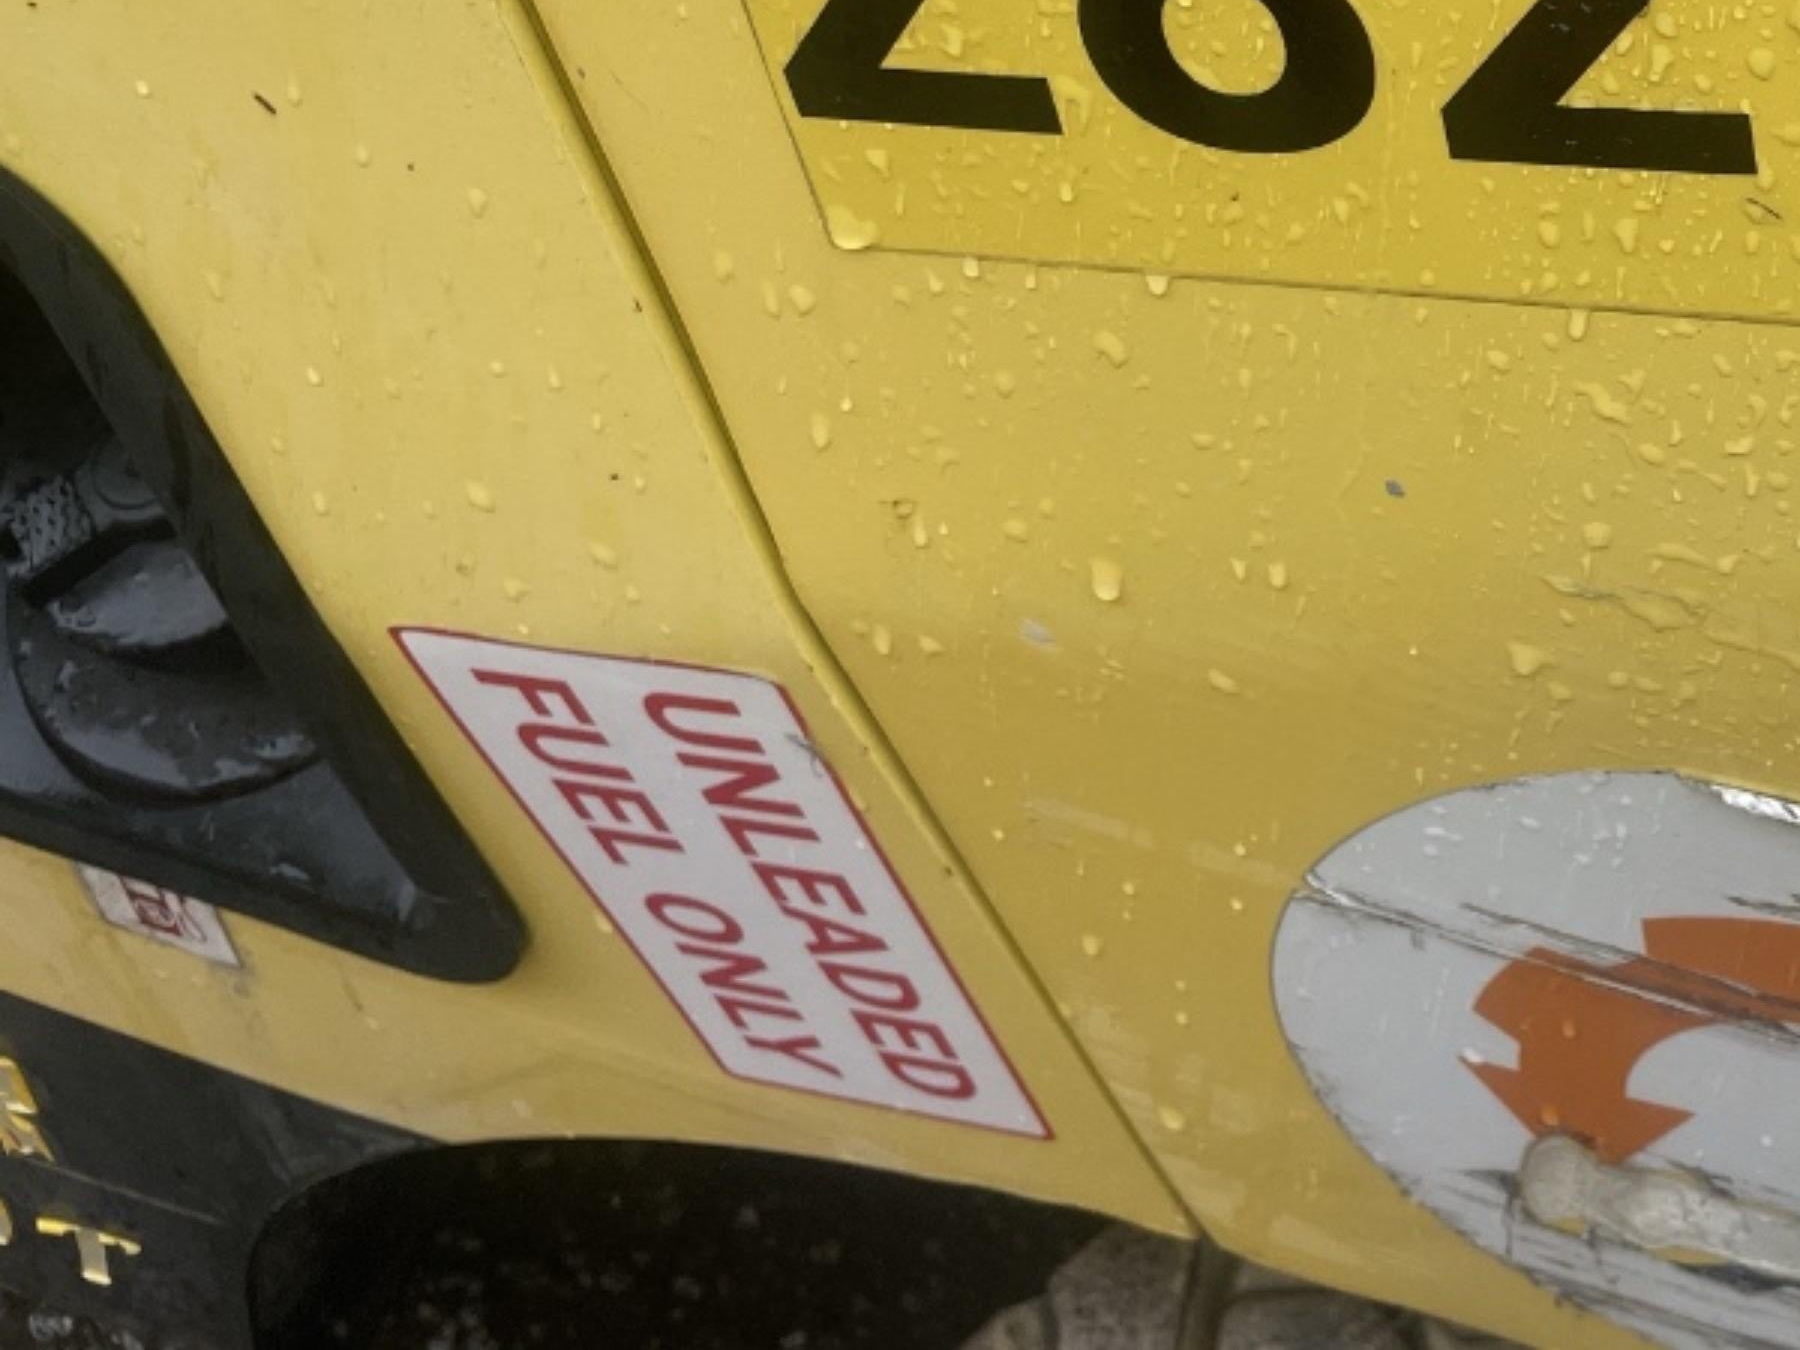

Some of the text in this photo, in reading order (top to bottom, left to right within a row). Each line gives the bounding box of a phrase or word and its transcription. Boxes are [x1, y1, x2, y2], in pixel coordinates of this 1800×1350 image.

[469, 667, 844, 1079] FUEL ONLY
[642, 691, 976, 1100] UNLEADED
